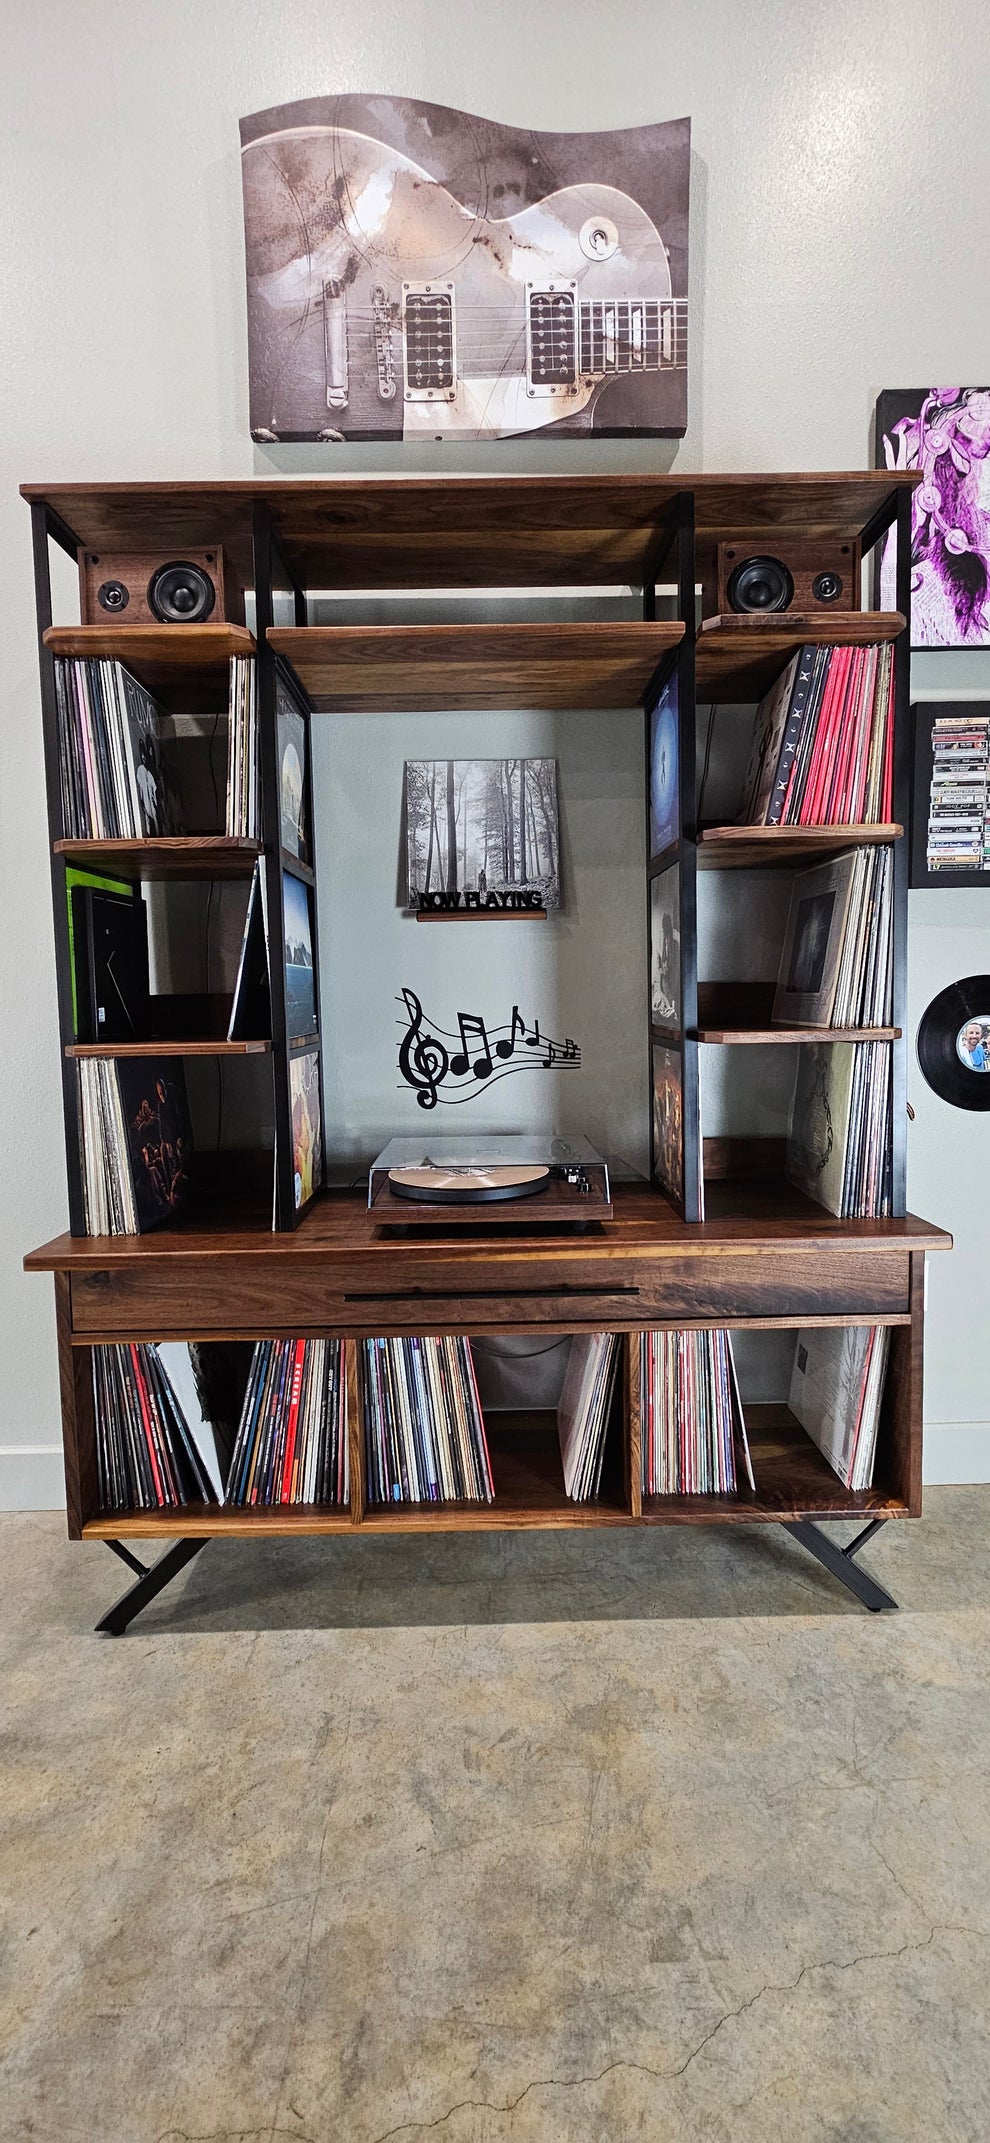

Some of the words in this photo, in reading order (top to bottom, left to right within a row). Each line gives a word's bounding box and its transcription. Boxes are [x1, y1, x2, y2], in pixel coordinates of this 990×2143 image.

[419, 891, 461, 909] NOW
[463, 890, 543, 909] PLAYING
[291, 1363, 302, 1405] SCREAM
